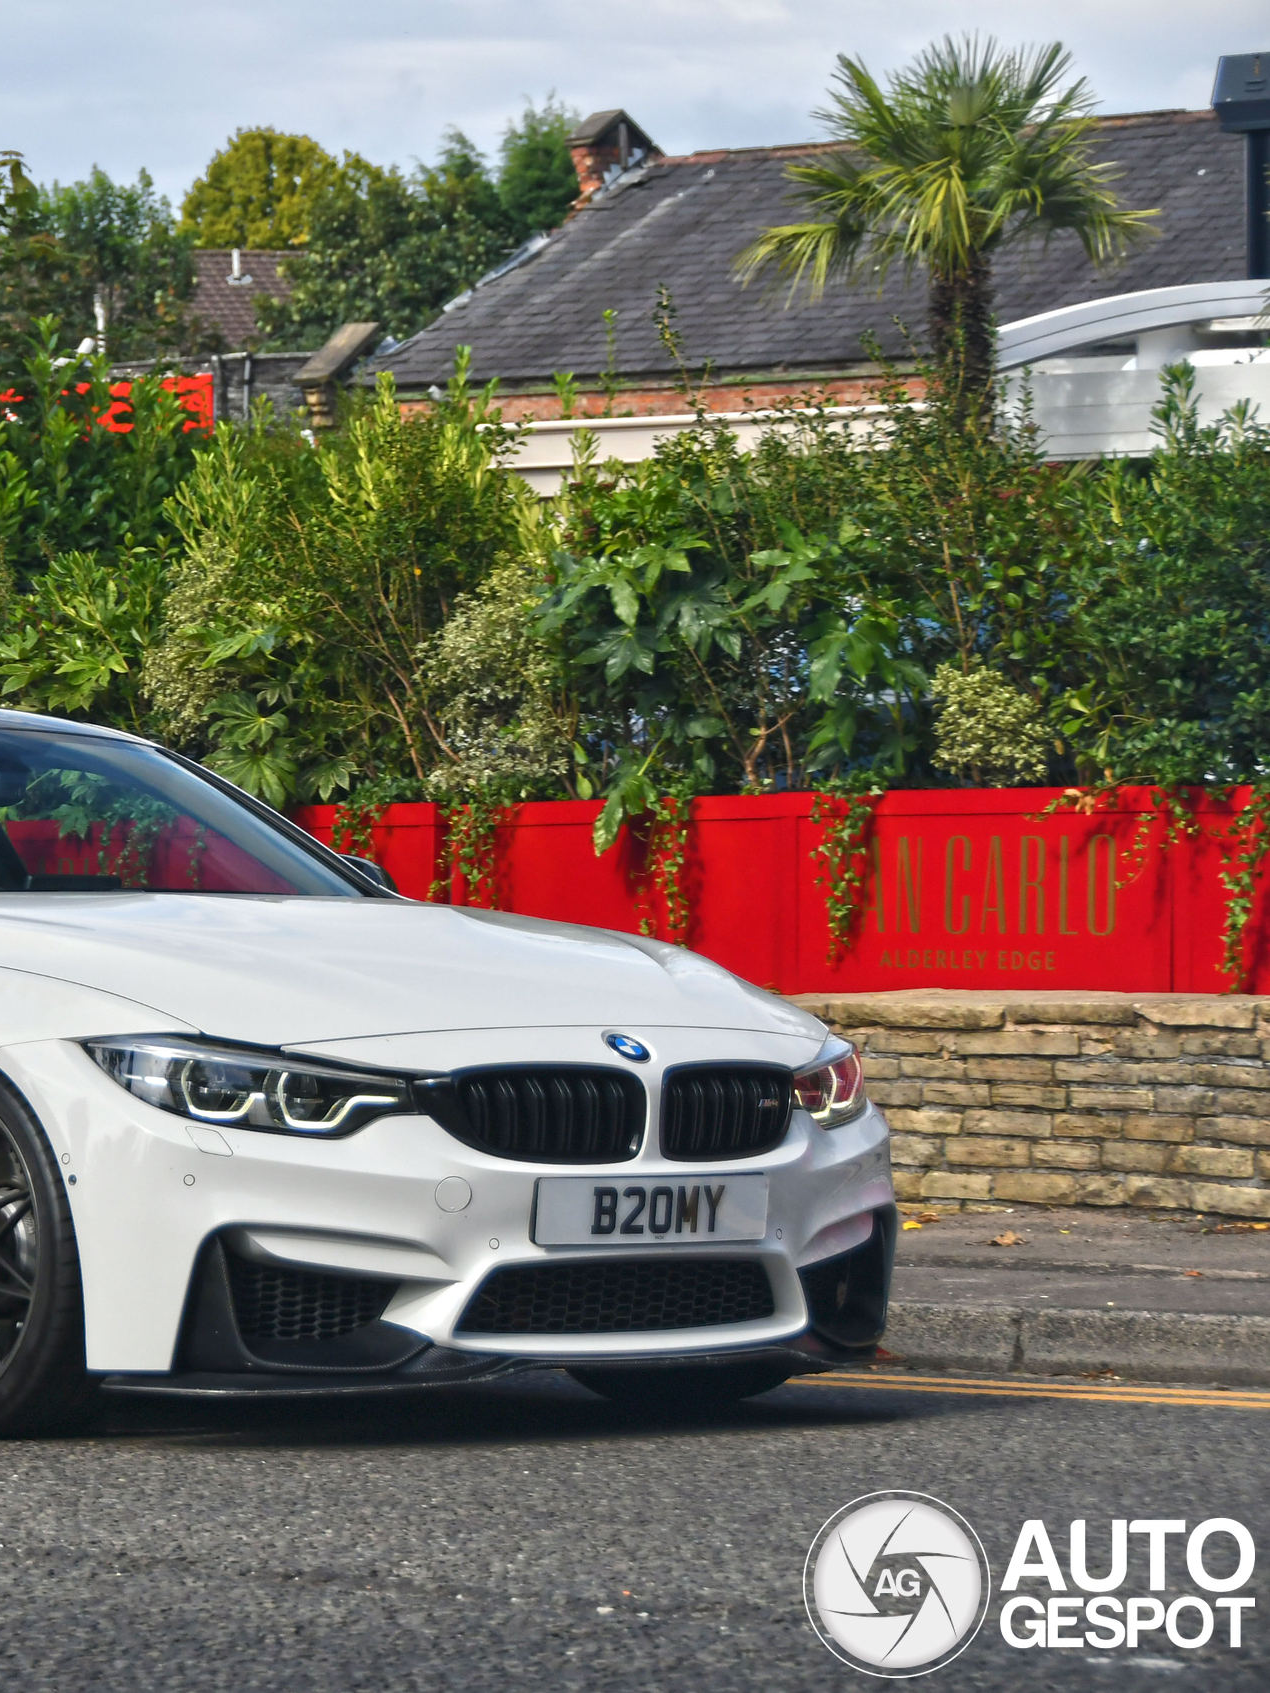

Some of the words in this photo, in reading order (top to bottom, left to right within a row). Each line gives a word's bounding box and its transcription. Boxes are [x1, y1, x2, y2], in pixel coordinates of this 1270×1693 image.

[943, 834, 1116, 936] CARLO
[879, 949, 988, 969] ALDERLEY
[997, 951, 1056, 971] EDGE
